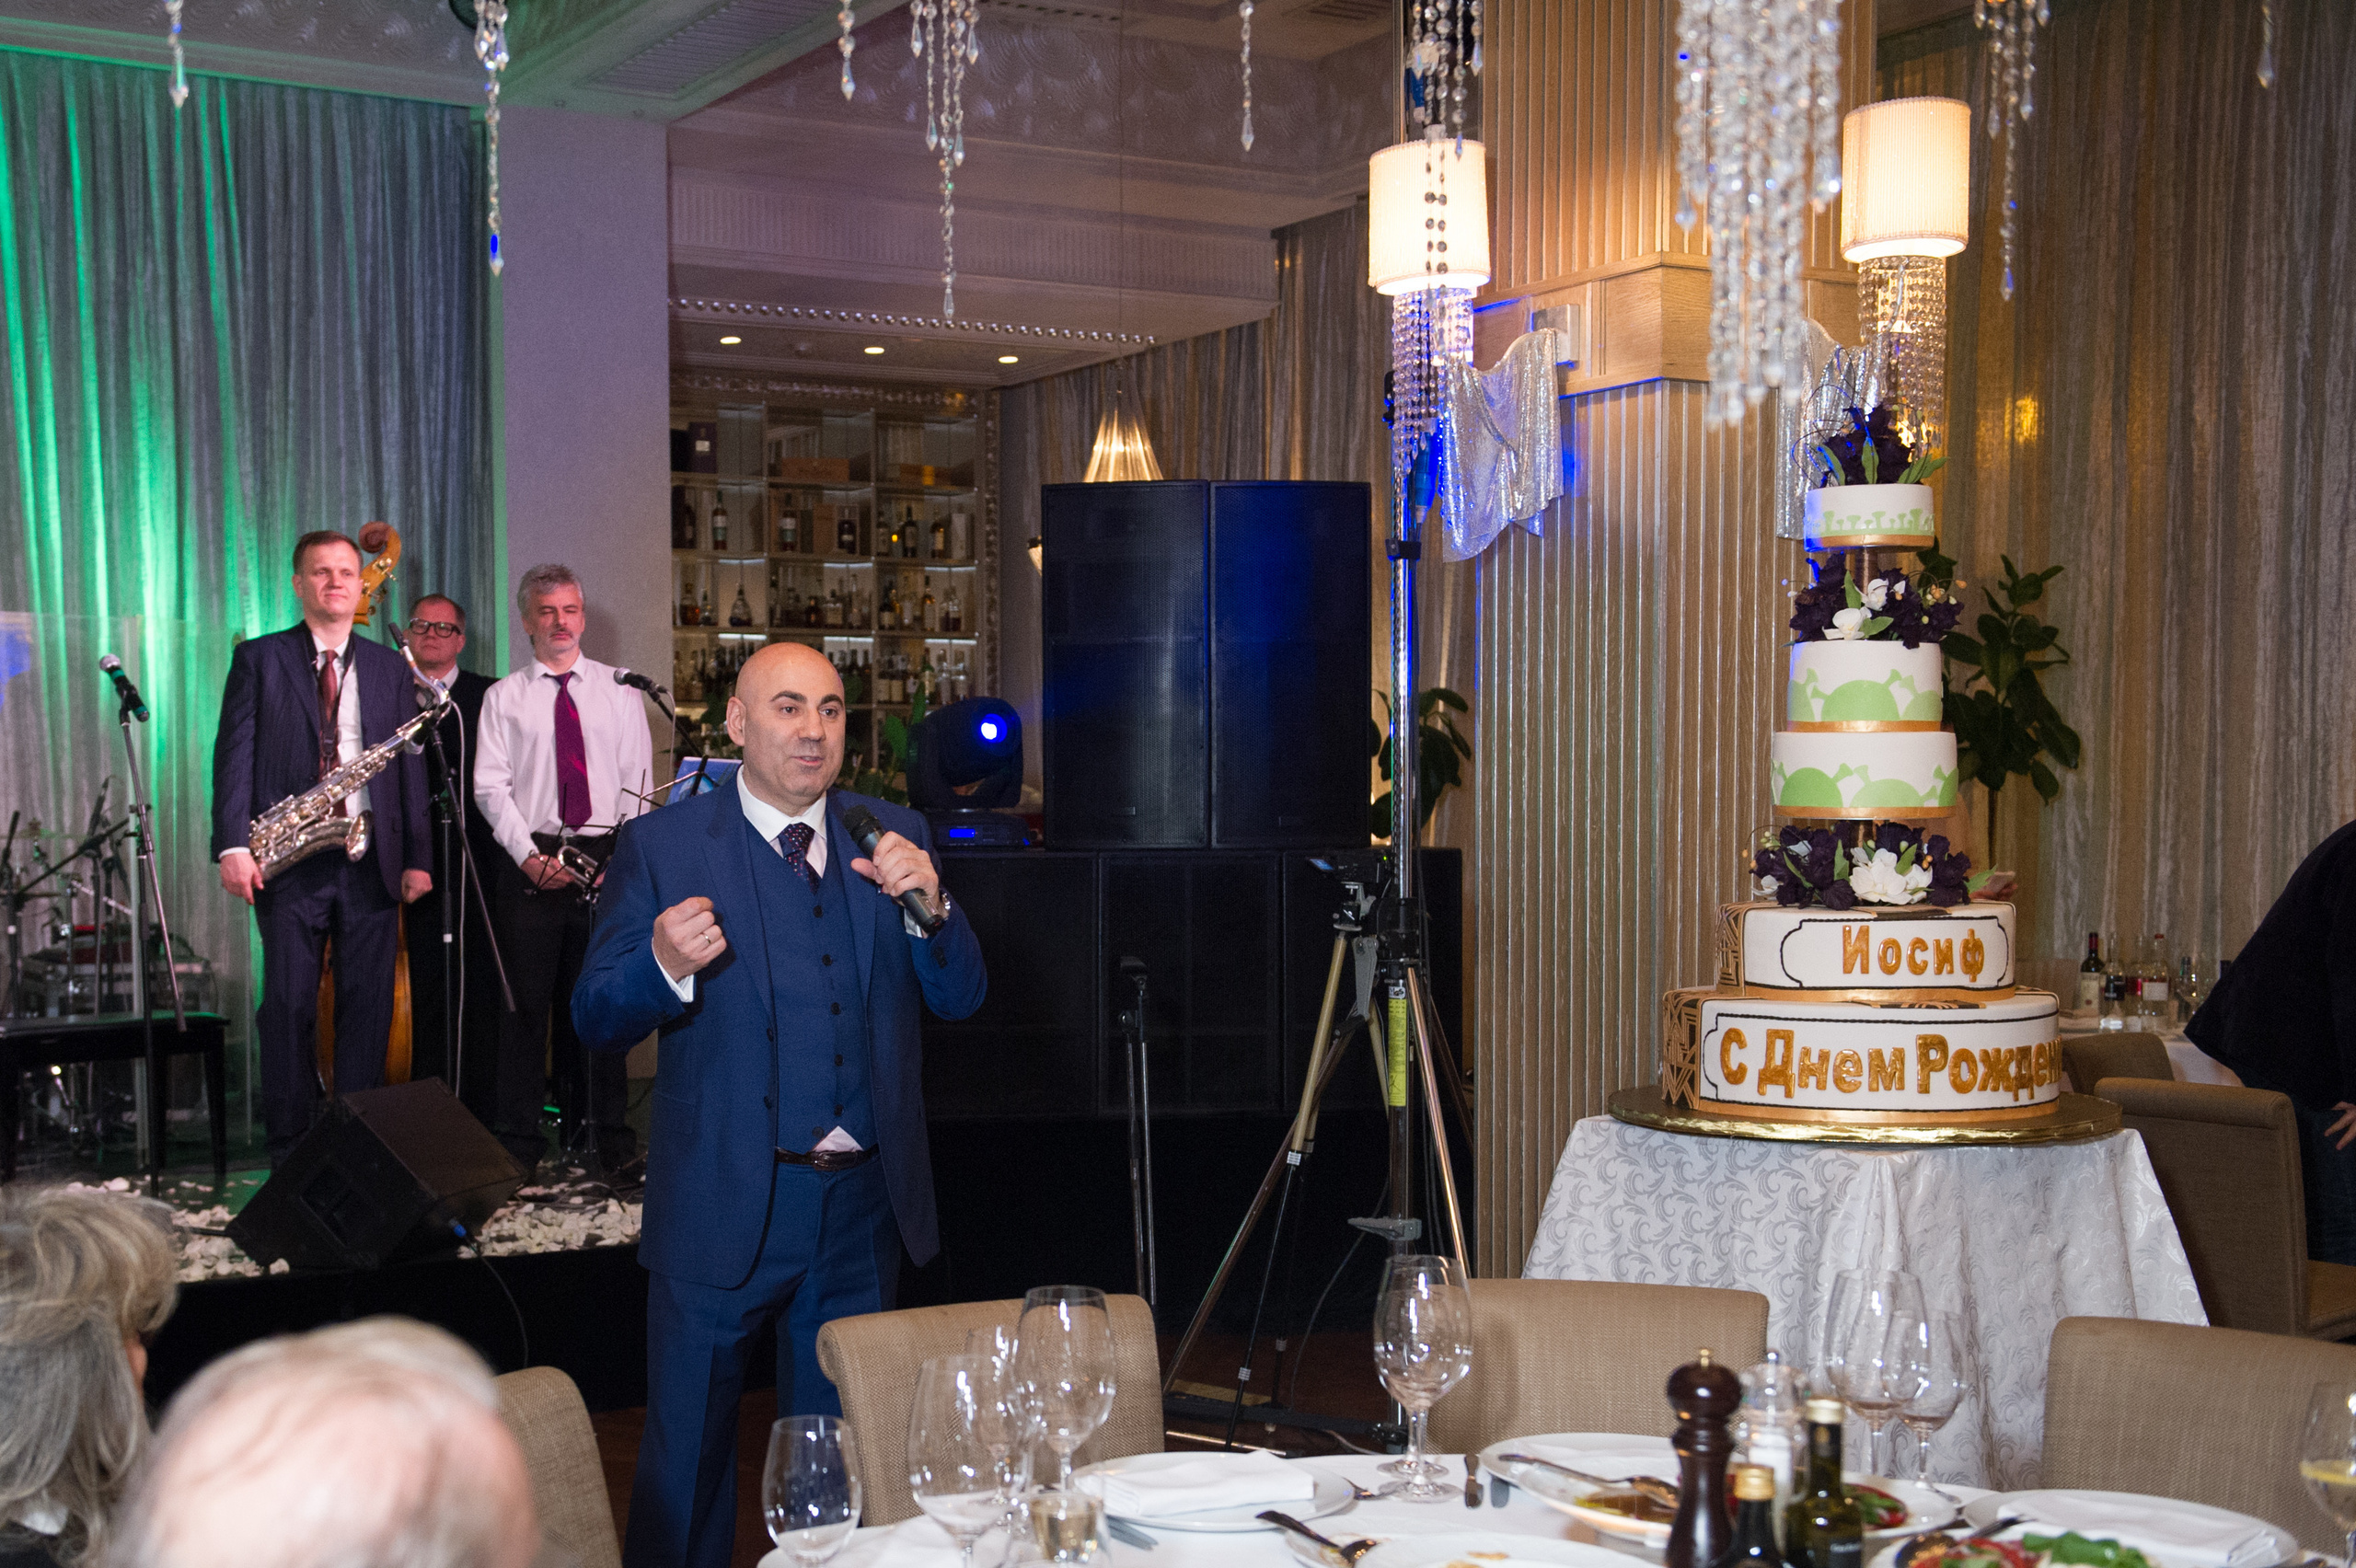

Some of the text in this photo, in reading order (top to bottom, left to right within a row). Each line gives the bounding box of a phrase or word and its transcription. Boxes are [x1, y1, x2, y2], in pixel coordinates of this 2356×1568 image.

[1842, 924, 1985, 983] Иосиф
[1719, 1027, 1749, 1085] С
[1757, 1028, 1906, 1099] Днем
